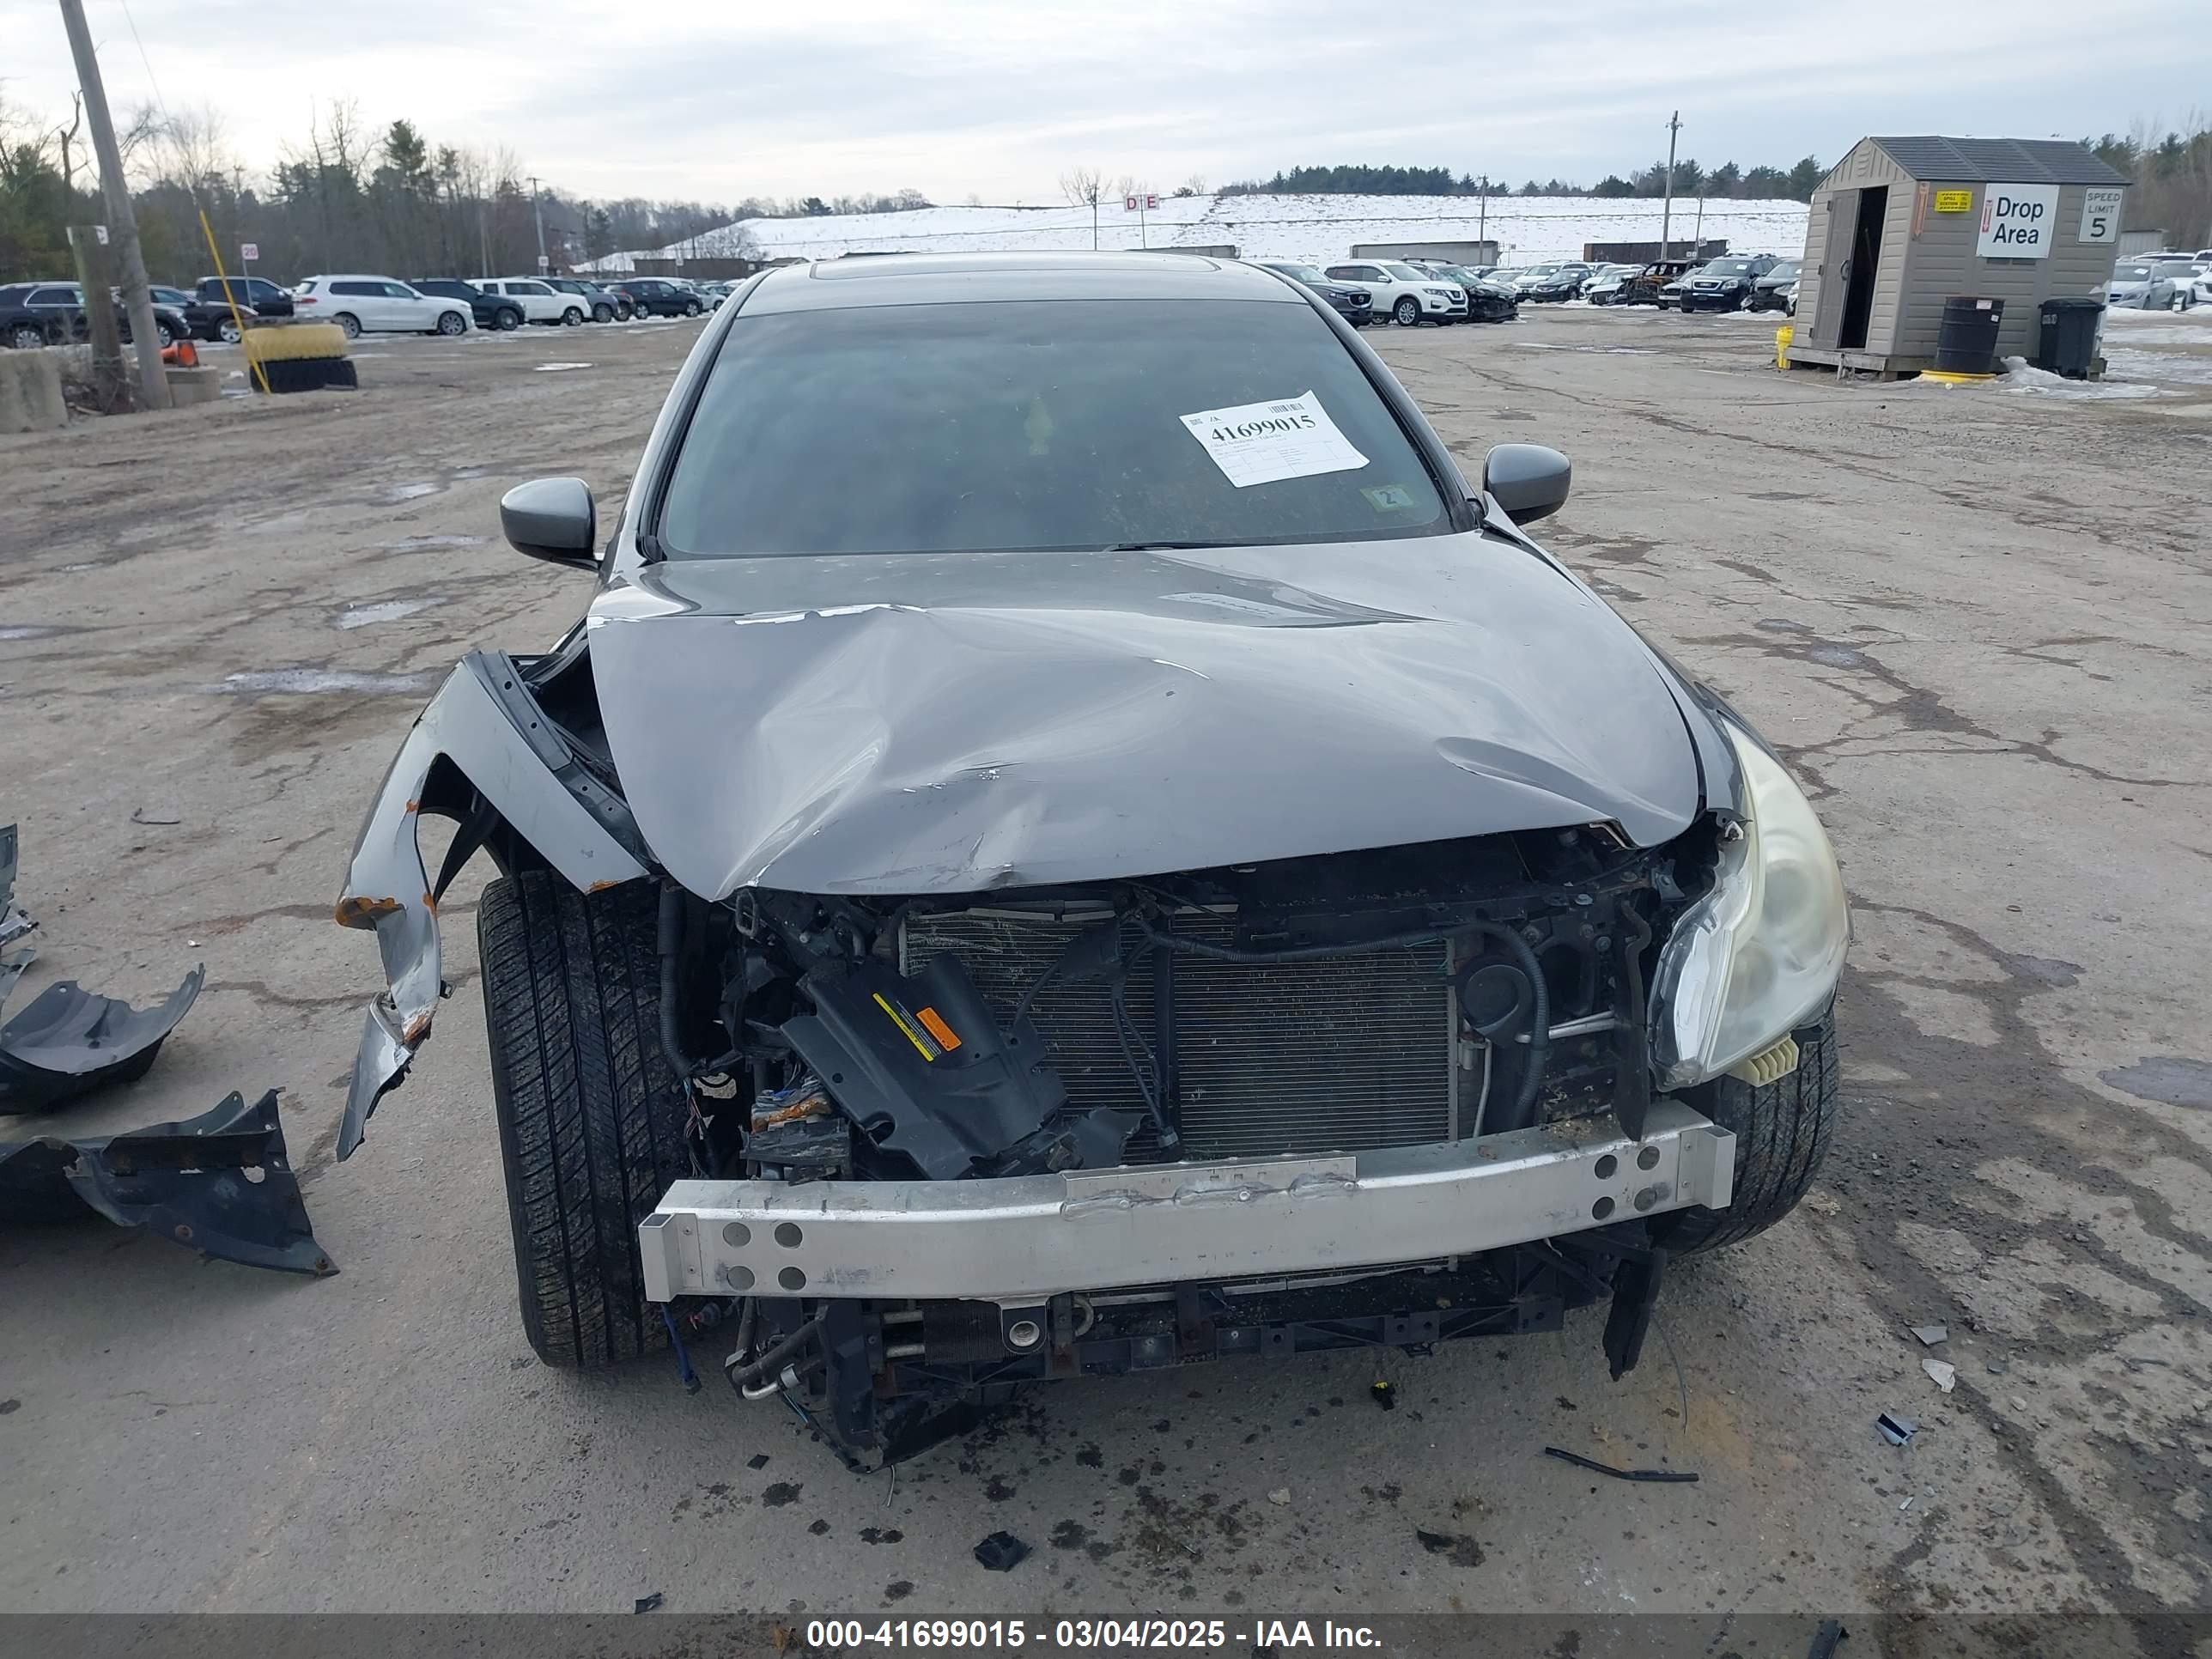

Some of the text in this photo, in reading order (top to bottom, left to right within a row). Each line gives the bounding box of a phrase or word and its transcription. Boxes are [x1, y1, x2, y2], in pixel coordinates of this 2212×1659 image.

[1127, 198, 1137, 210] D
[1147, 197, 1157, 209] E
[2087, 192, 2120, 202] SPEED
[1996, 197, 2044, 222] Drop
[1992, 223, 2039, 244] Area
[2090, 217, 2106, 238] 5
[244, 247, 257, 256] 20
[1212, 415, 1316, 441] 41699015
[1379, 491, 1397, 505] 2
